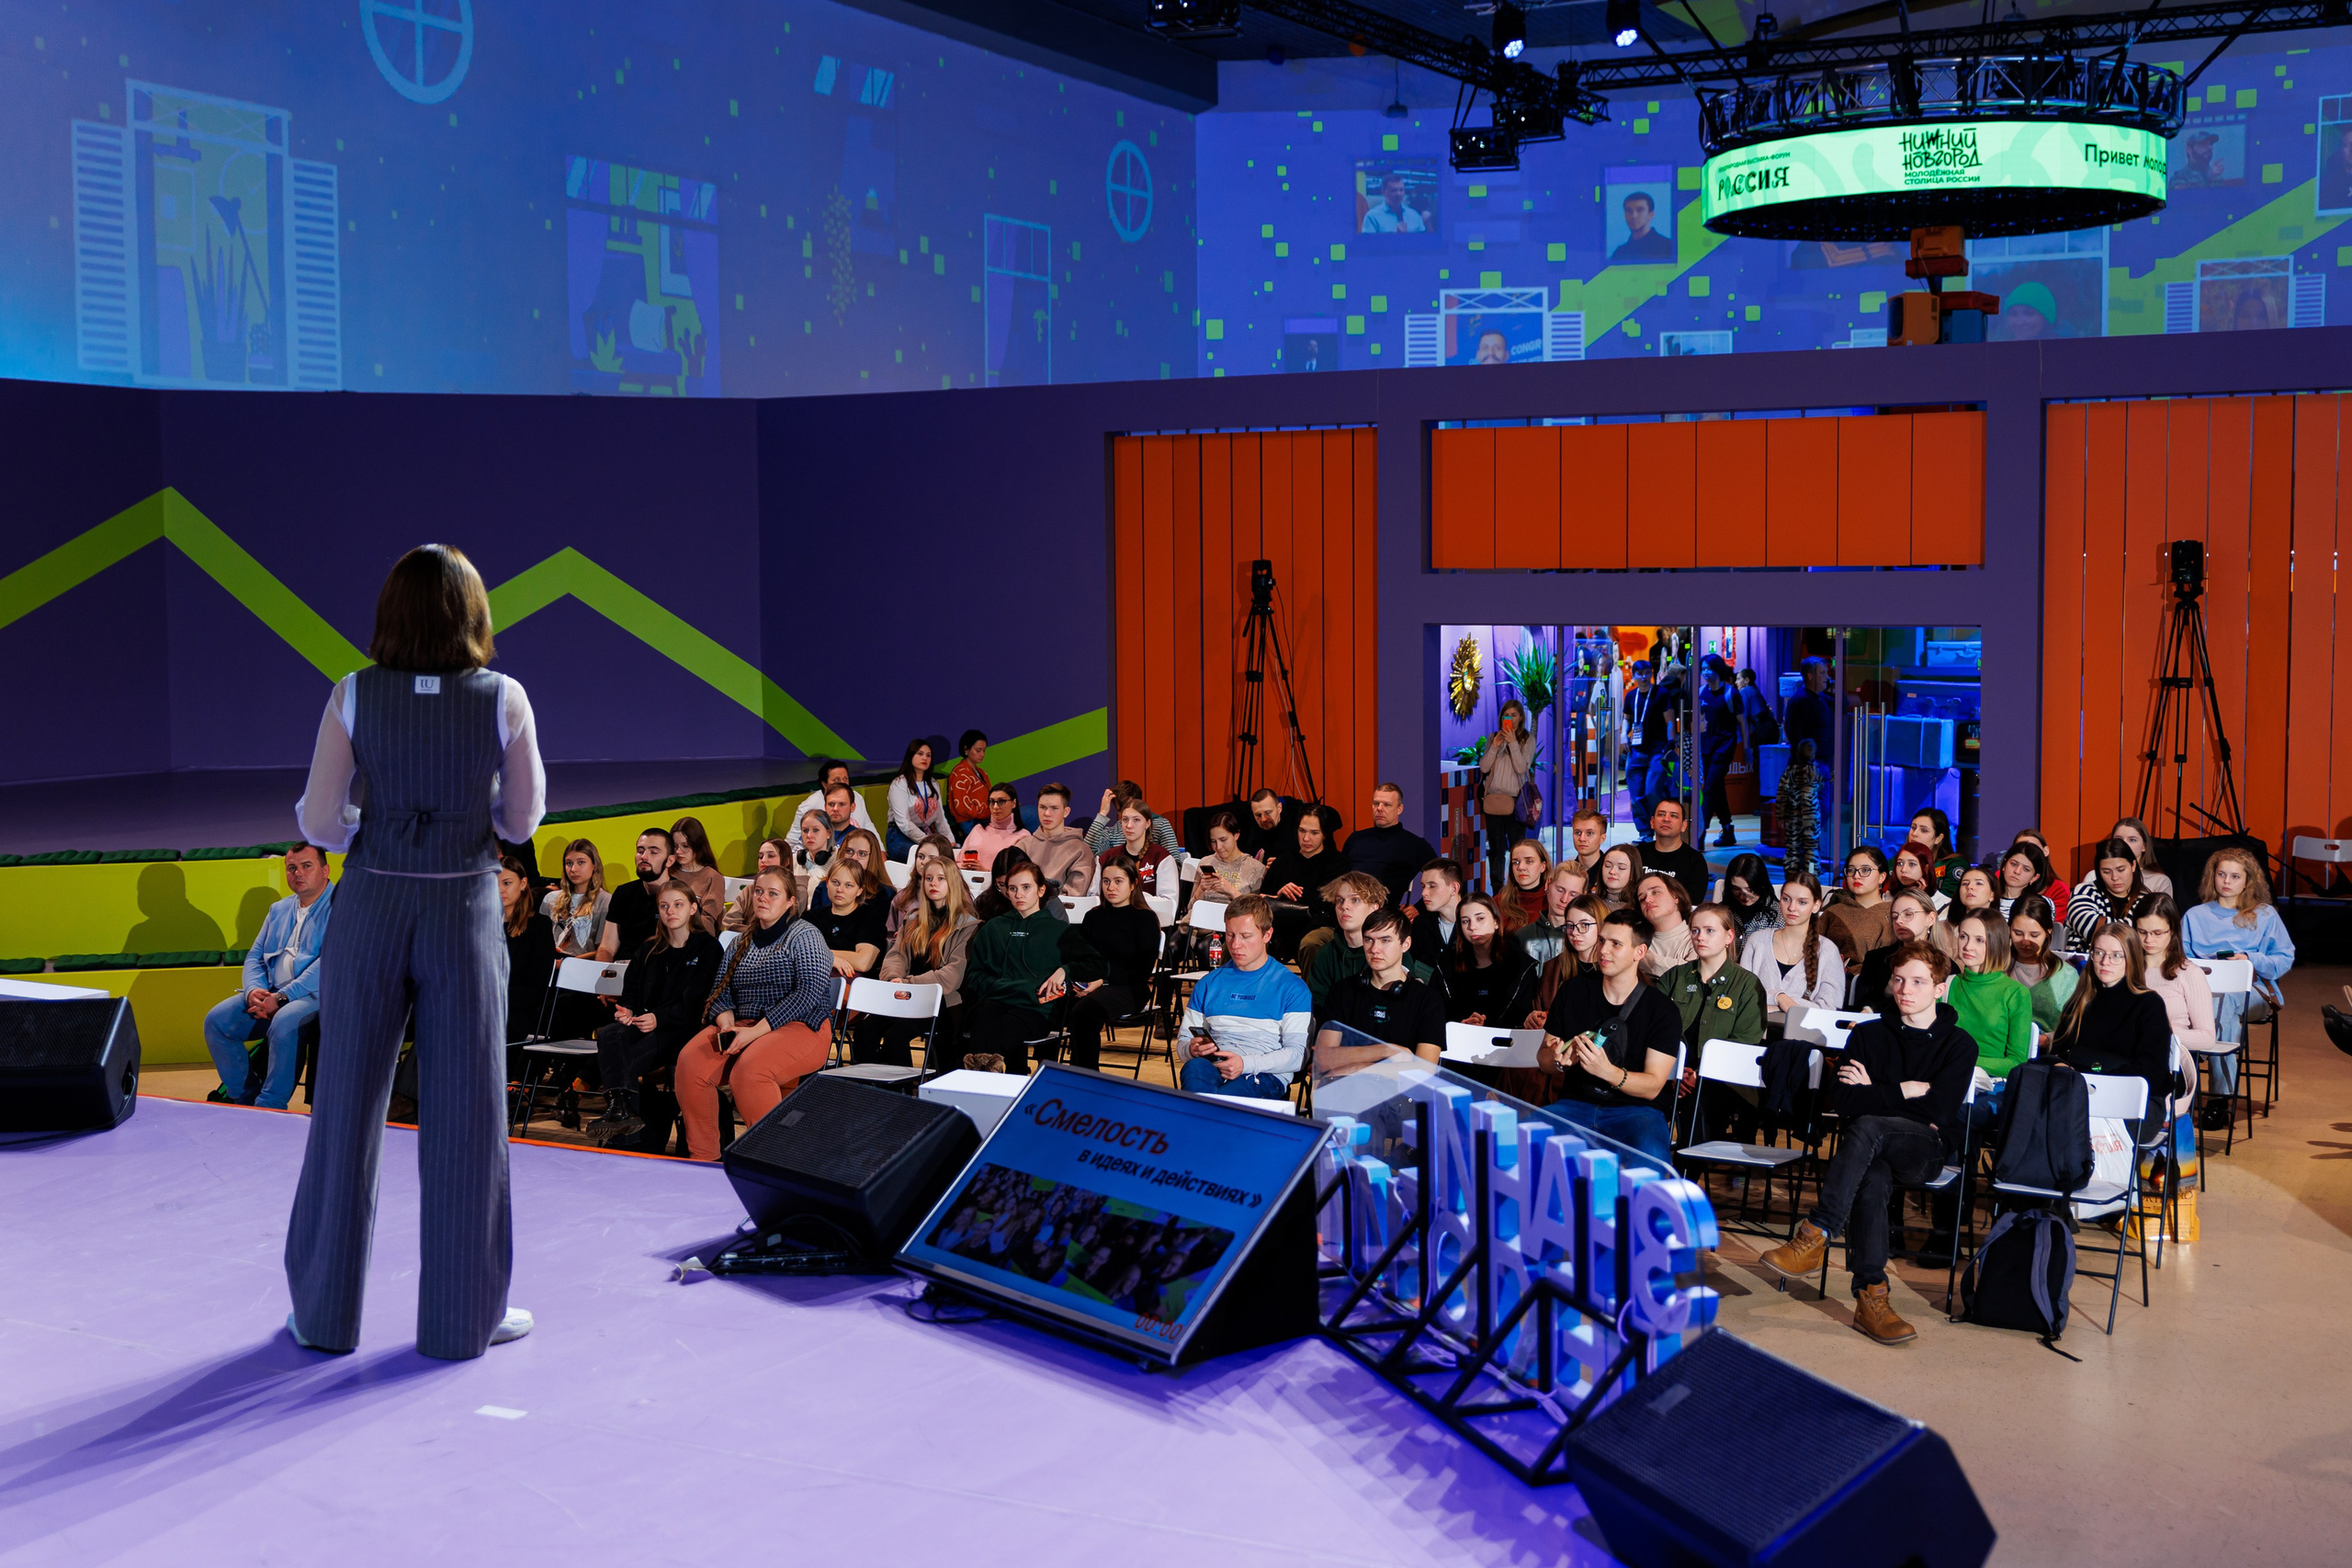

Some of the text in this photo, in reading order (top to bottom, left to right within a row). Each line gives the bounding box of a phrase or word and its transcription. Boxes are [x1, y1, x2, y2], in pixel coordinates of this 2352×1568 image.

[1902, 147, 1983, 171] НОВГОРОД
[2085, 143, 2140, 167] Привет
[1718, 166, 1790, 200] РОССИЯ
[1905, 169, 1965, 178] МОЛОДЁЖНАЯ
[1905, 175, 1980, 186] СТОЛИЦА РОССИИ
[1024, 1098, 1170, 1155] «Смелость
[1077, 1149, 1091, 1163] в
[1090, 1151, 1143, 1178] идеях
[1139, 1166, 1157, 1180] и
[1135, 1312, 1182, 1340] 00:00
